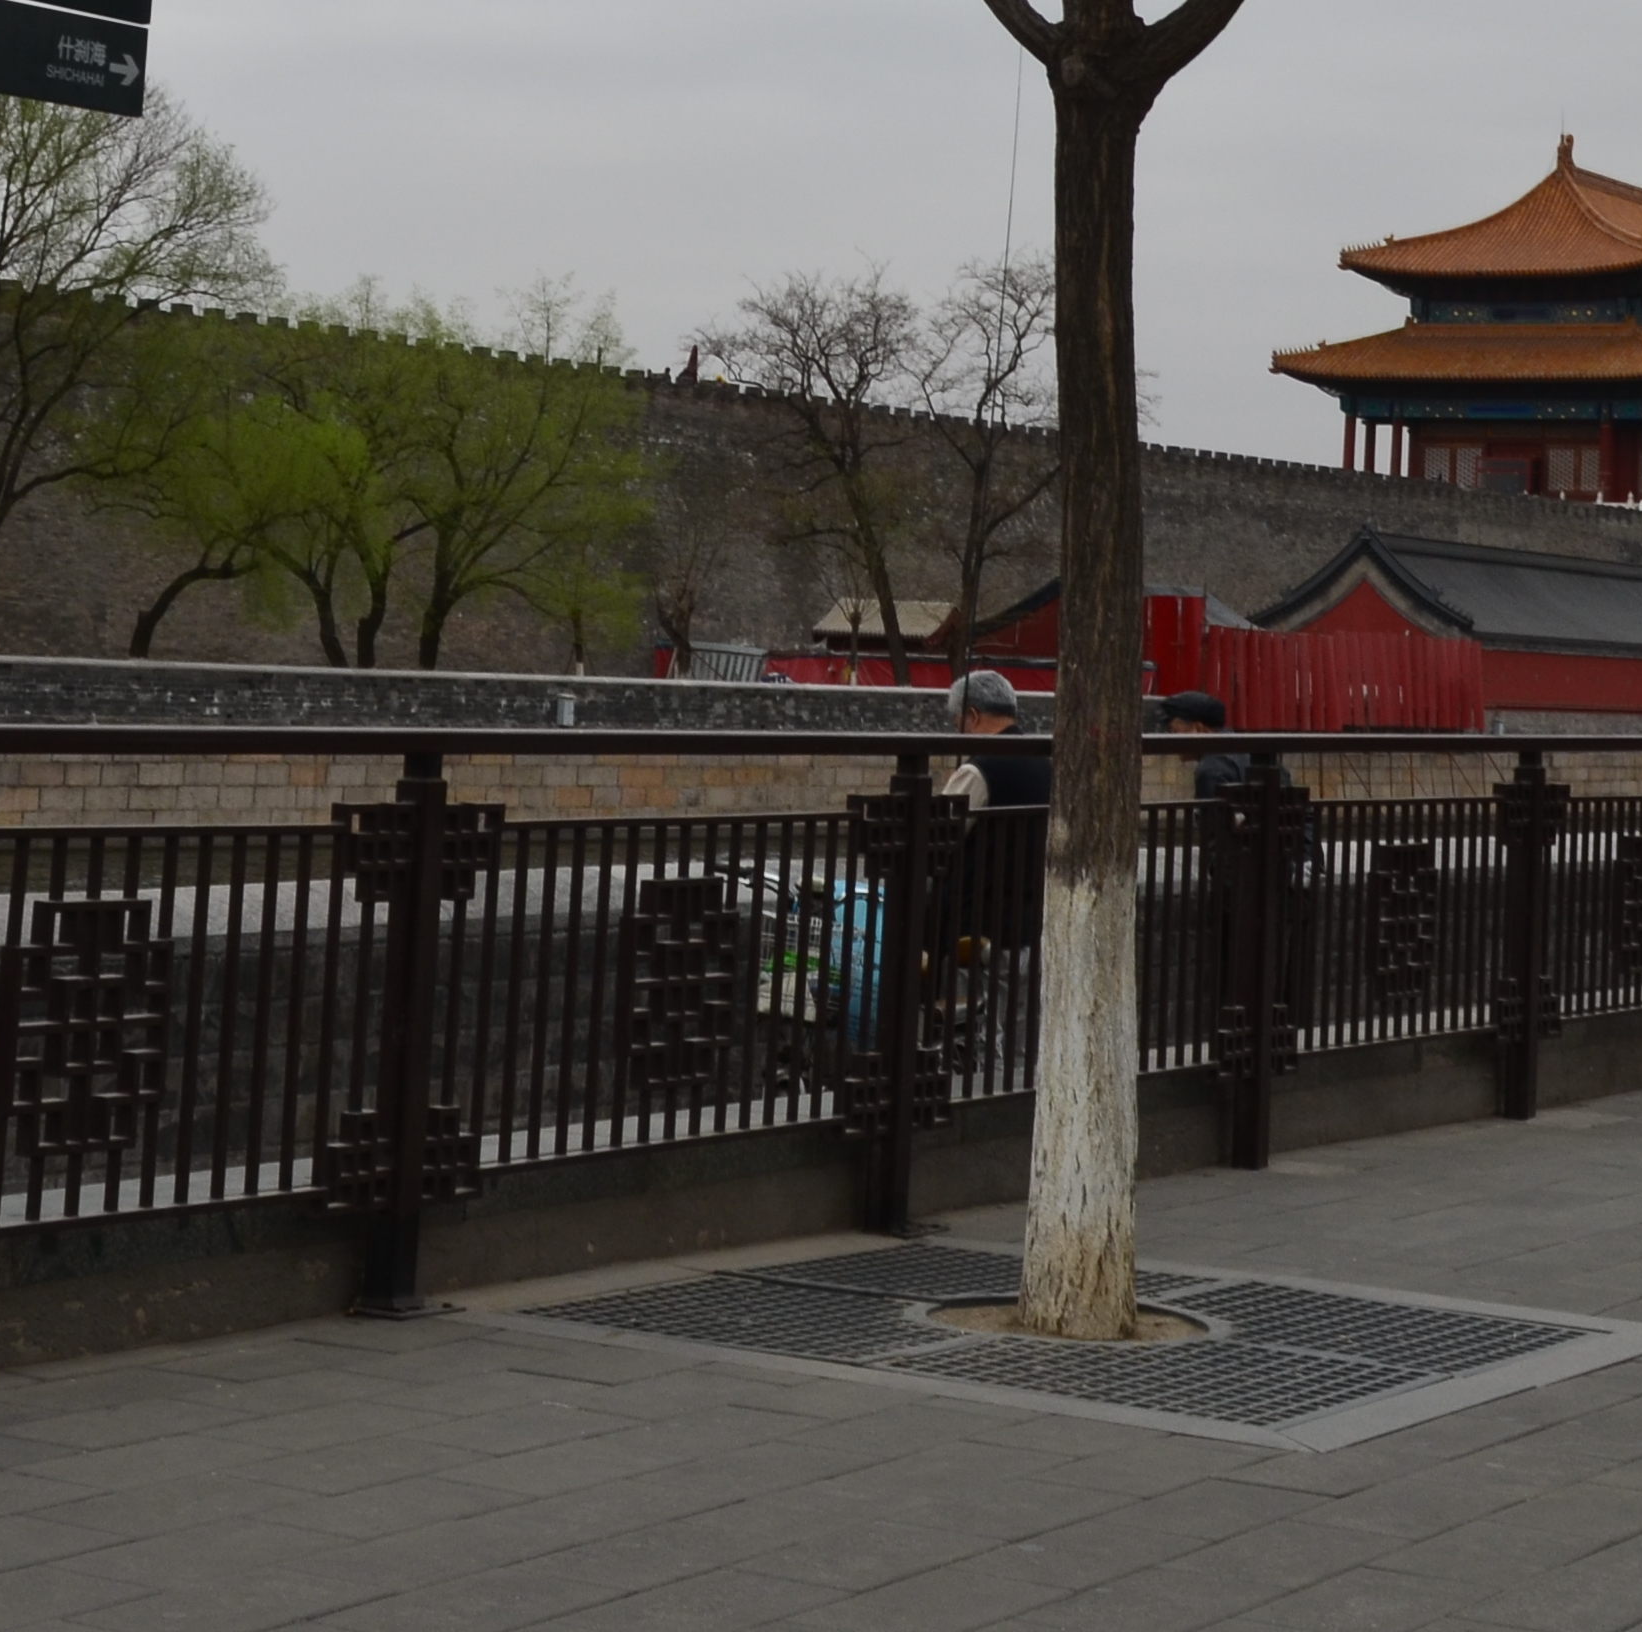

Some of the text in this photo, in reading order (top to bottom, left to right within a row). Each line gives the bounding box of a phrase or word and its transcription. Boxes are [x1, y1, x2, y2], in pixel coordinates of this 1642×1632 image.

[57, 35, 107, 67] 什刹海
[45, 64, 104, 87] SHICHAHAI
